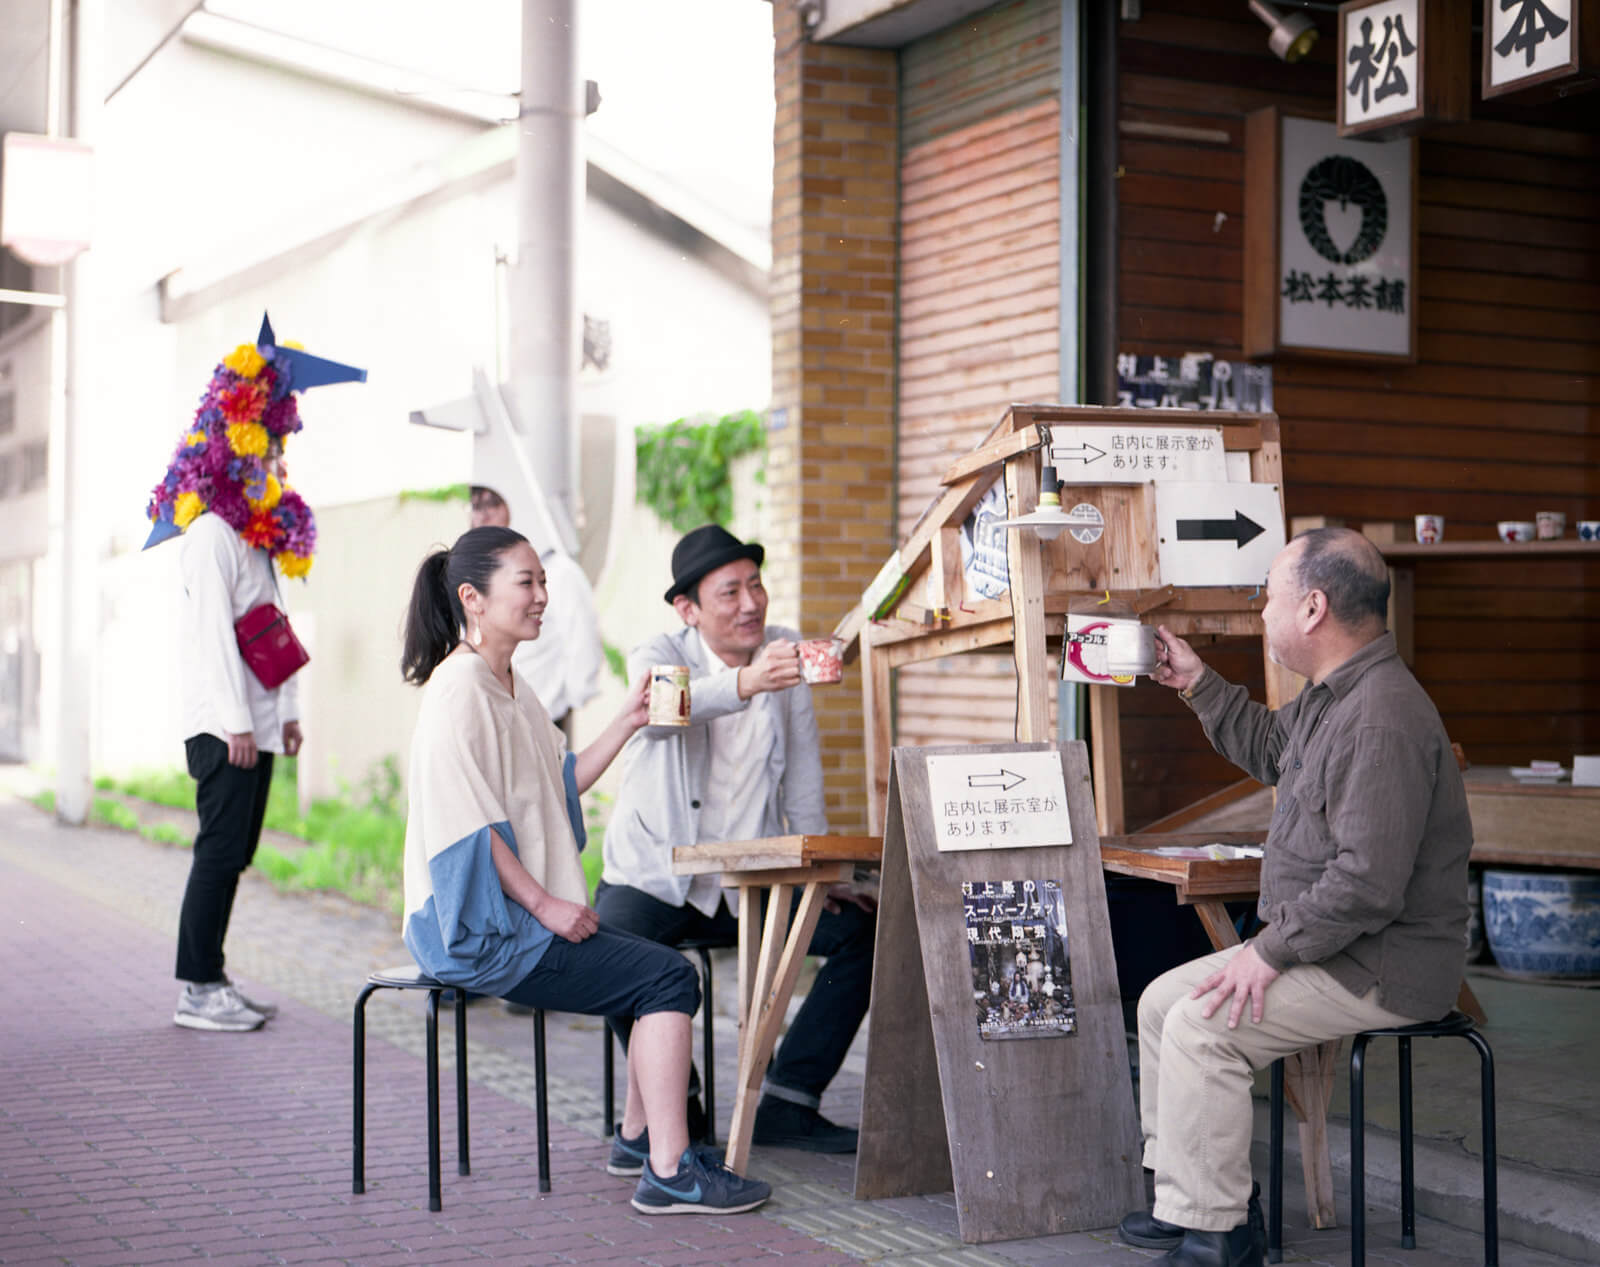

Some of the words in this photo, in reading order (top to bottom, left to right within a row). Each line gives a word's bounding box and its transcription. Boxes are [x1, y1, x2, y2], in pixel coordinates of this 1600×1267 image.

[1494, 0, 1569, 68] 本
[1347, 14, 1416, 113] 松
[1111, 434, 1214, 451] 店内に展示室が
[944, 797, 1057, 817] 店内に展示室が
